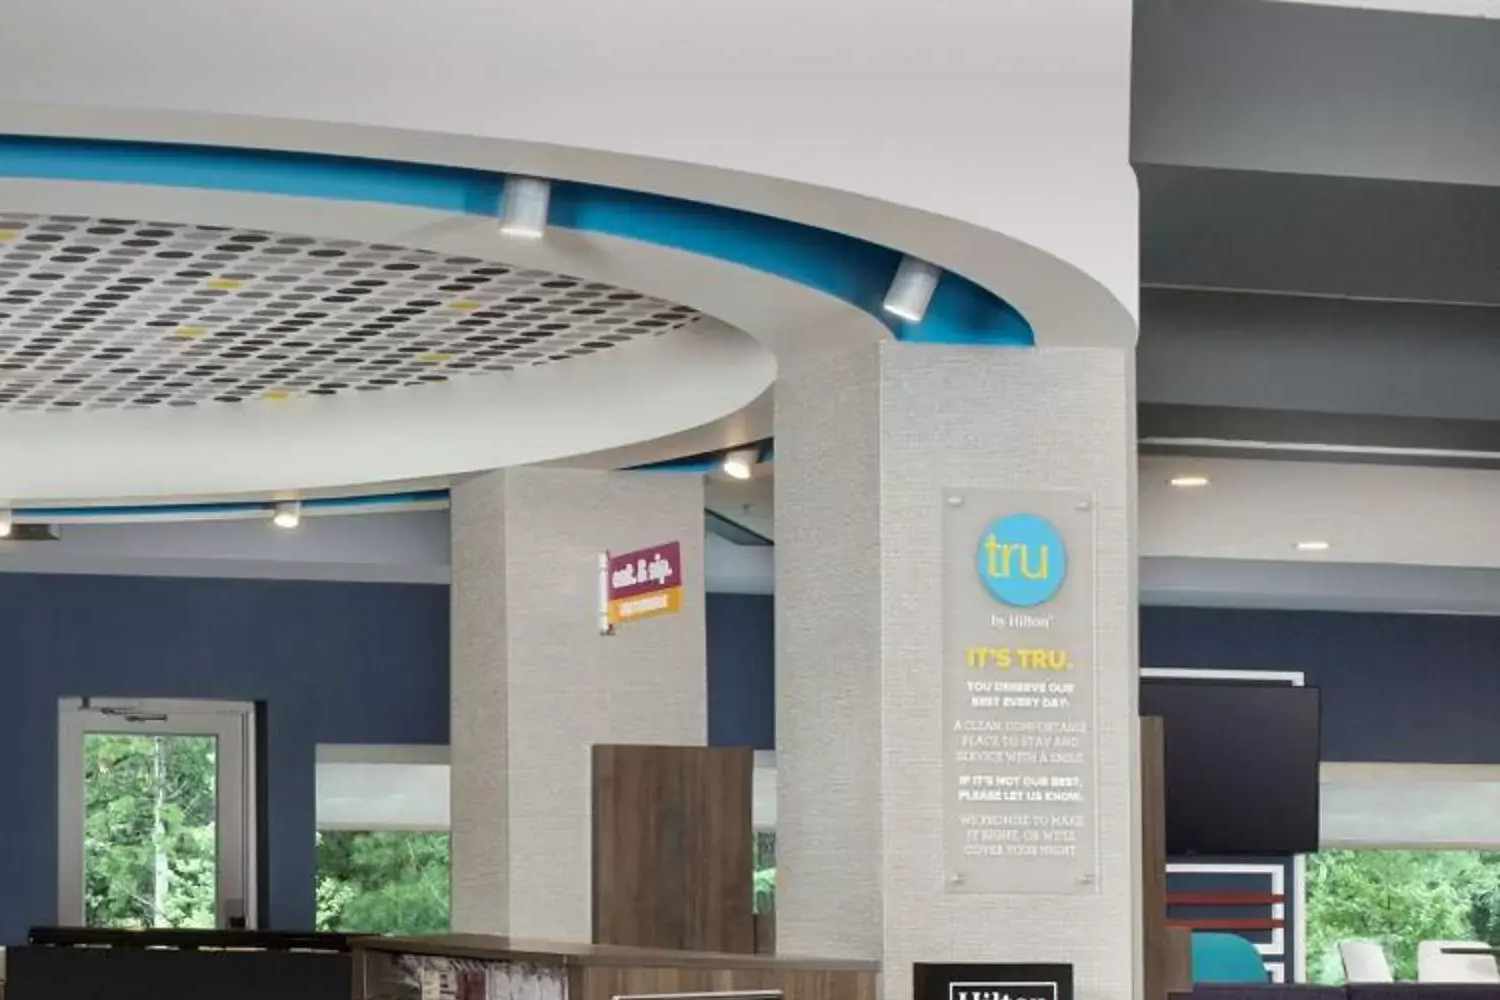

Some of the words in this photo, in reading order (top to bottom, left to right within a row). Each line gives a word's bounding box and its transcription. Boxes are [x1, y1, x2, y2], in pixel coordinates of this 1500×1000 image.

[984, 533, 1049, 579] tru
[991, 613, 1006, 630] by
[965, 647, 1012, 670] IT'S
[1016, 648, 1074, 671] TRU.
[966, 680, 992, 692] YOU
[994, 681, 1047, 693] DESERVE
[1048, 681, 1076, 694] OUR
[971, 696, 1001, 708] BEST
[1003, 696, 1040, 708] EVERY
[996, 775, 1021, 786] NOT
